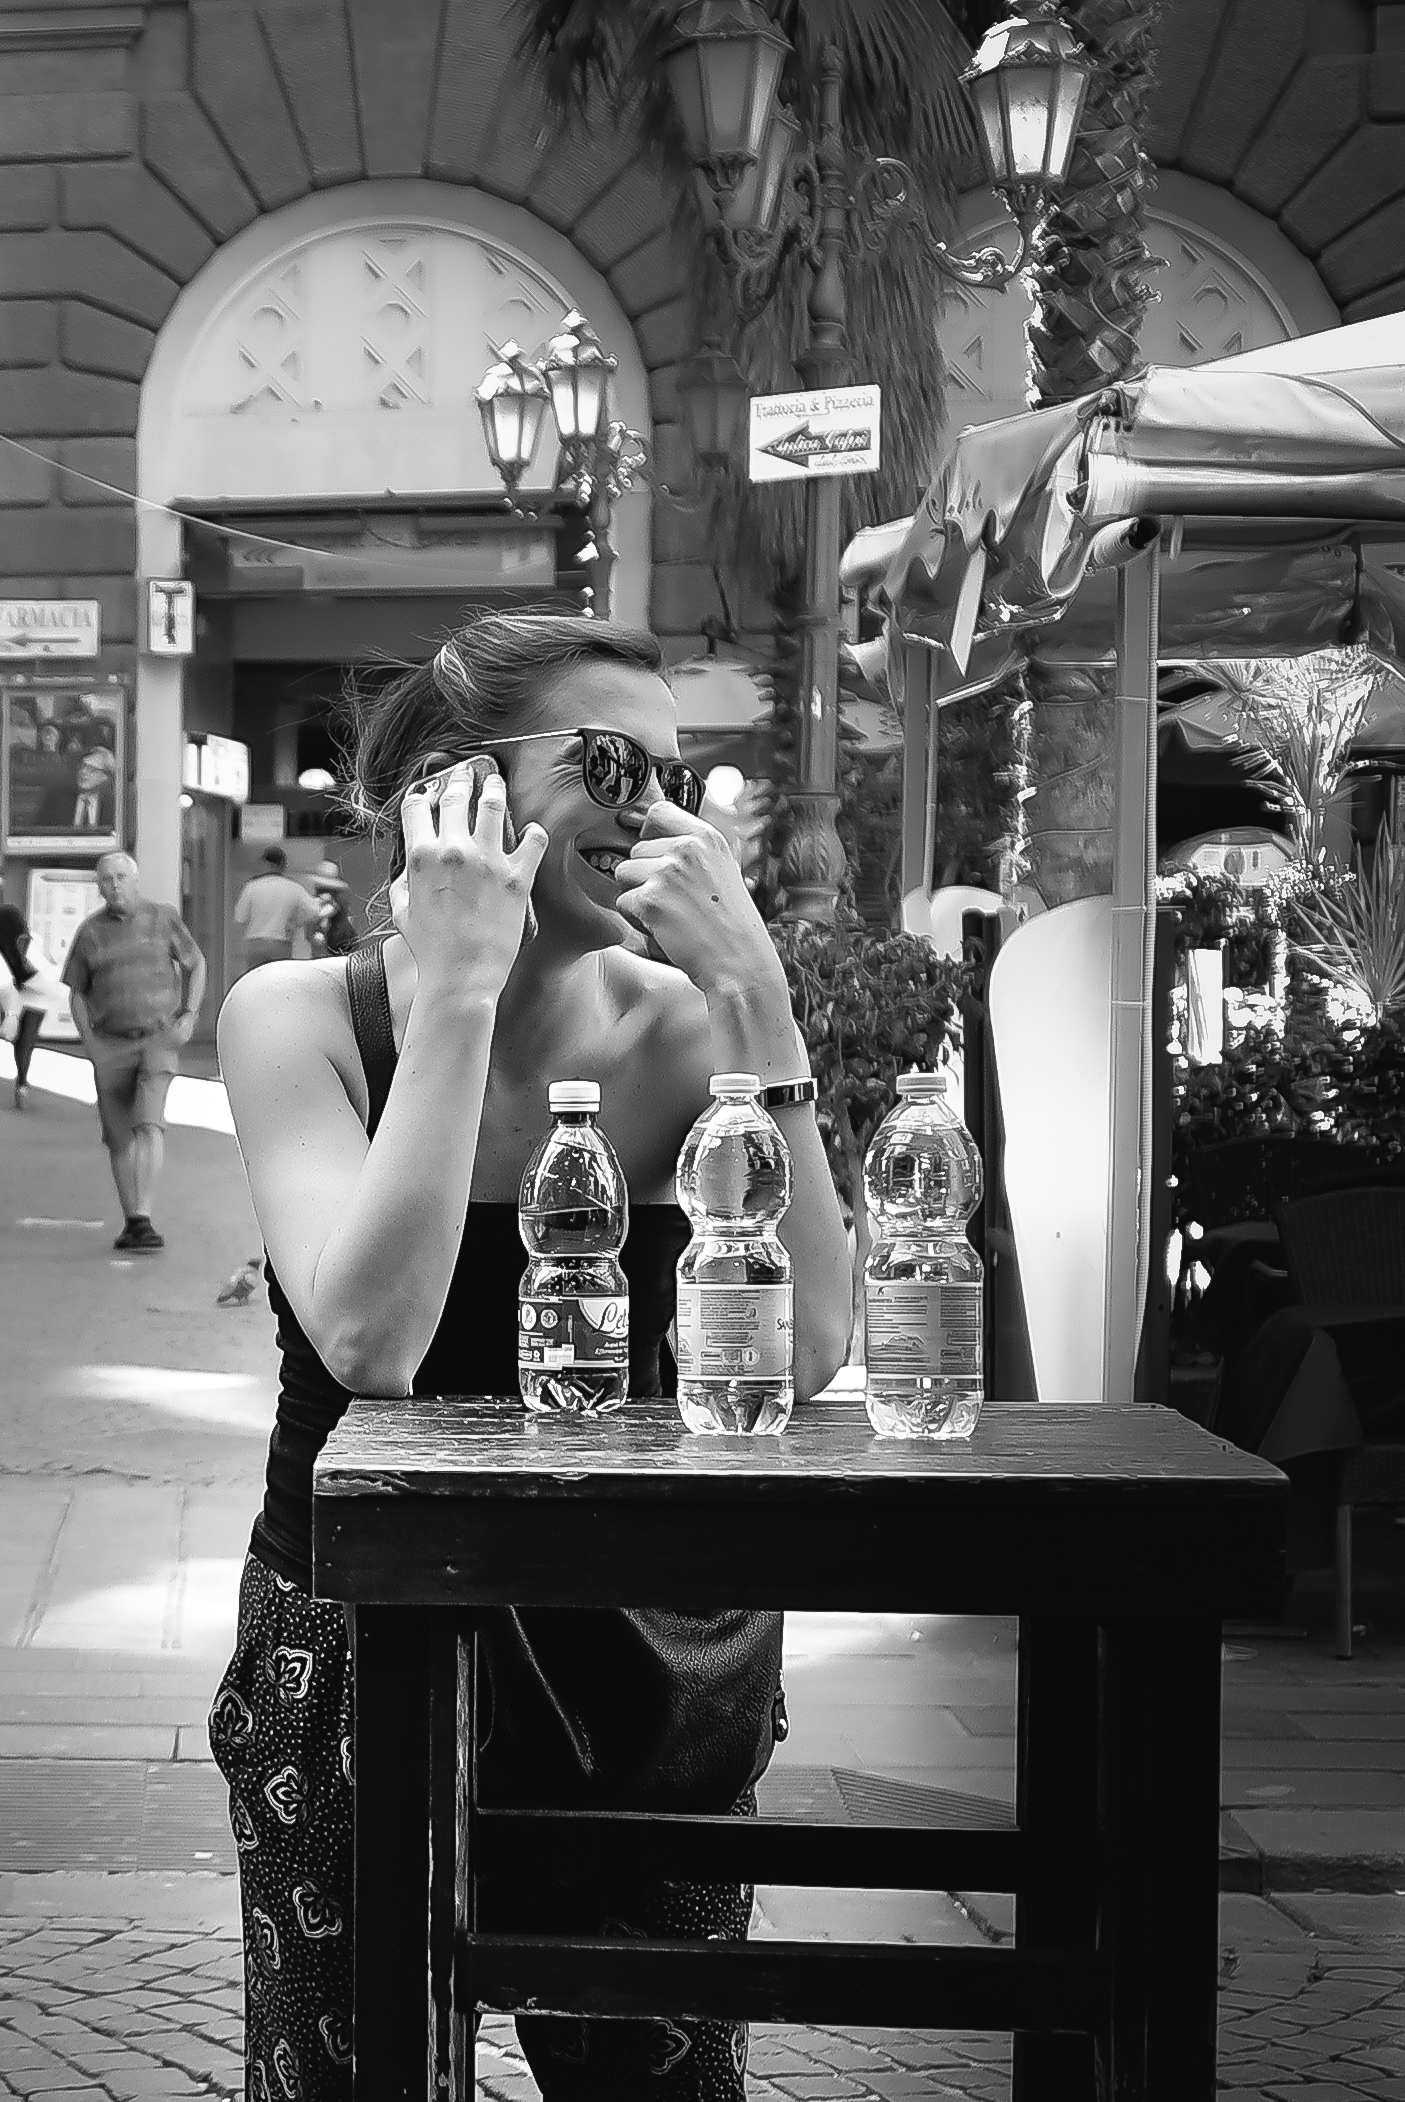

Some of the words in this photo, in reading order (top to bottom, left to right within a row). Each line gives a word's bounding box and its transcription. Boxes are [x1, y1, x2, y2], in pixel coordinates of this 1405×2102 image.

[752, 399, 806, 420] Trattoria
[810, 397, 820, 412] &
[824, 392, 874, 415] Pizzeria
[0, 605, 92, 628] ARMACIA
[154, 585, 187, 645] T
